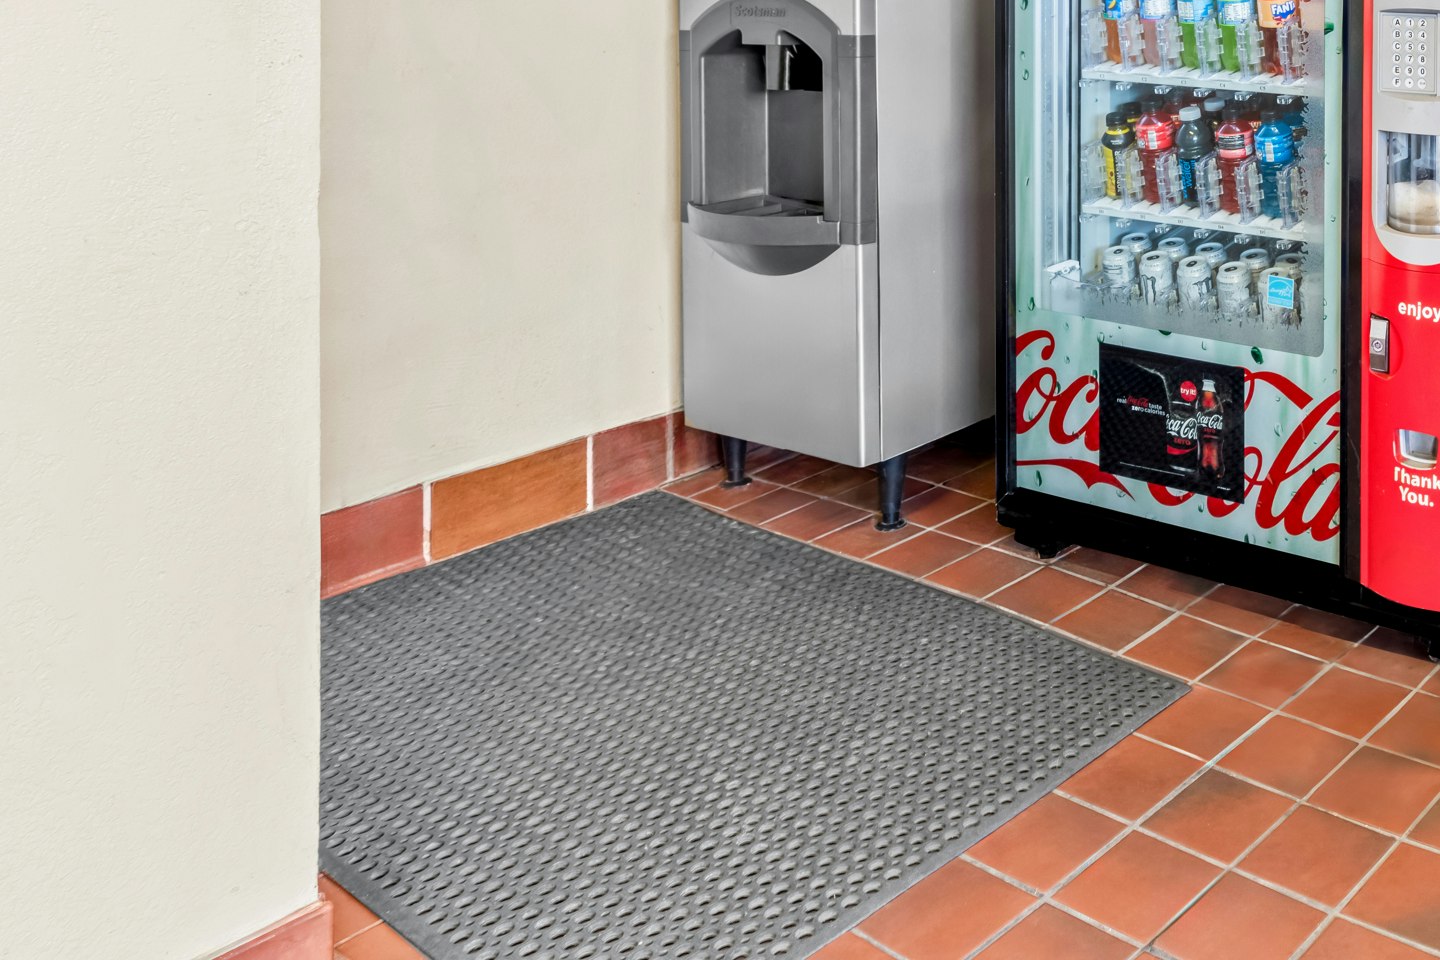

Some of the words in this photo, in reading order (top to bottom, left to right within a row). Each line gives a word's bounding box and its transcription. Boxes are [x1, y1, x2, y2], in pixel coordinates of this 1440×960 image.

[734, 4, 788, 20] Scotsman
[1180, 387, 1190, 398] try
[1144, 406, 1166, 416] calories
[1174, 438, 1191, 446] zero
[1399, 485, 1434, 507] You.
